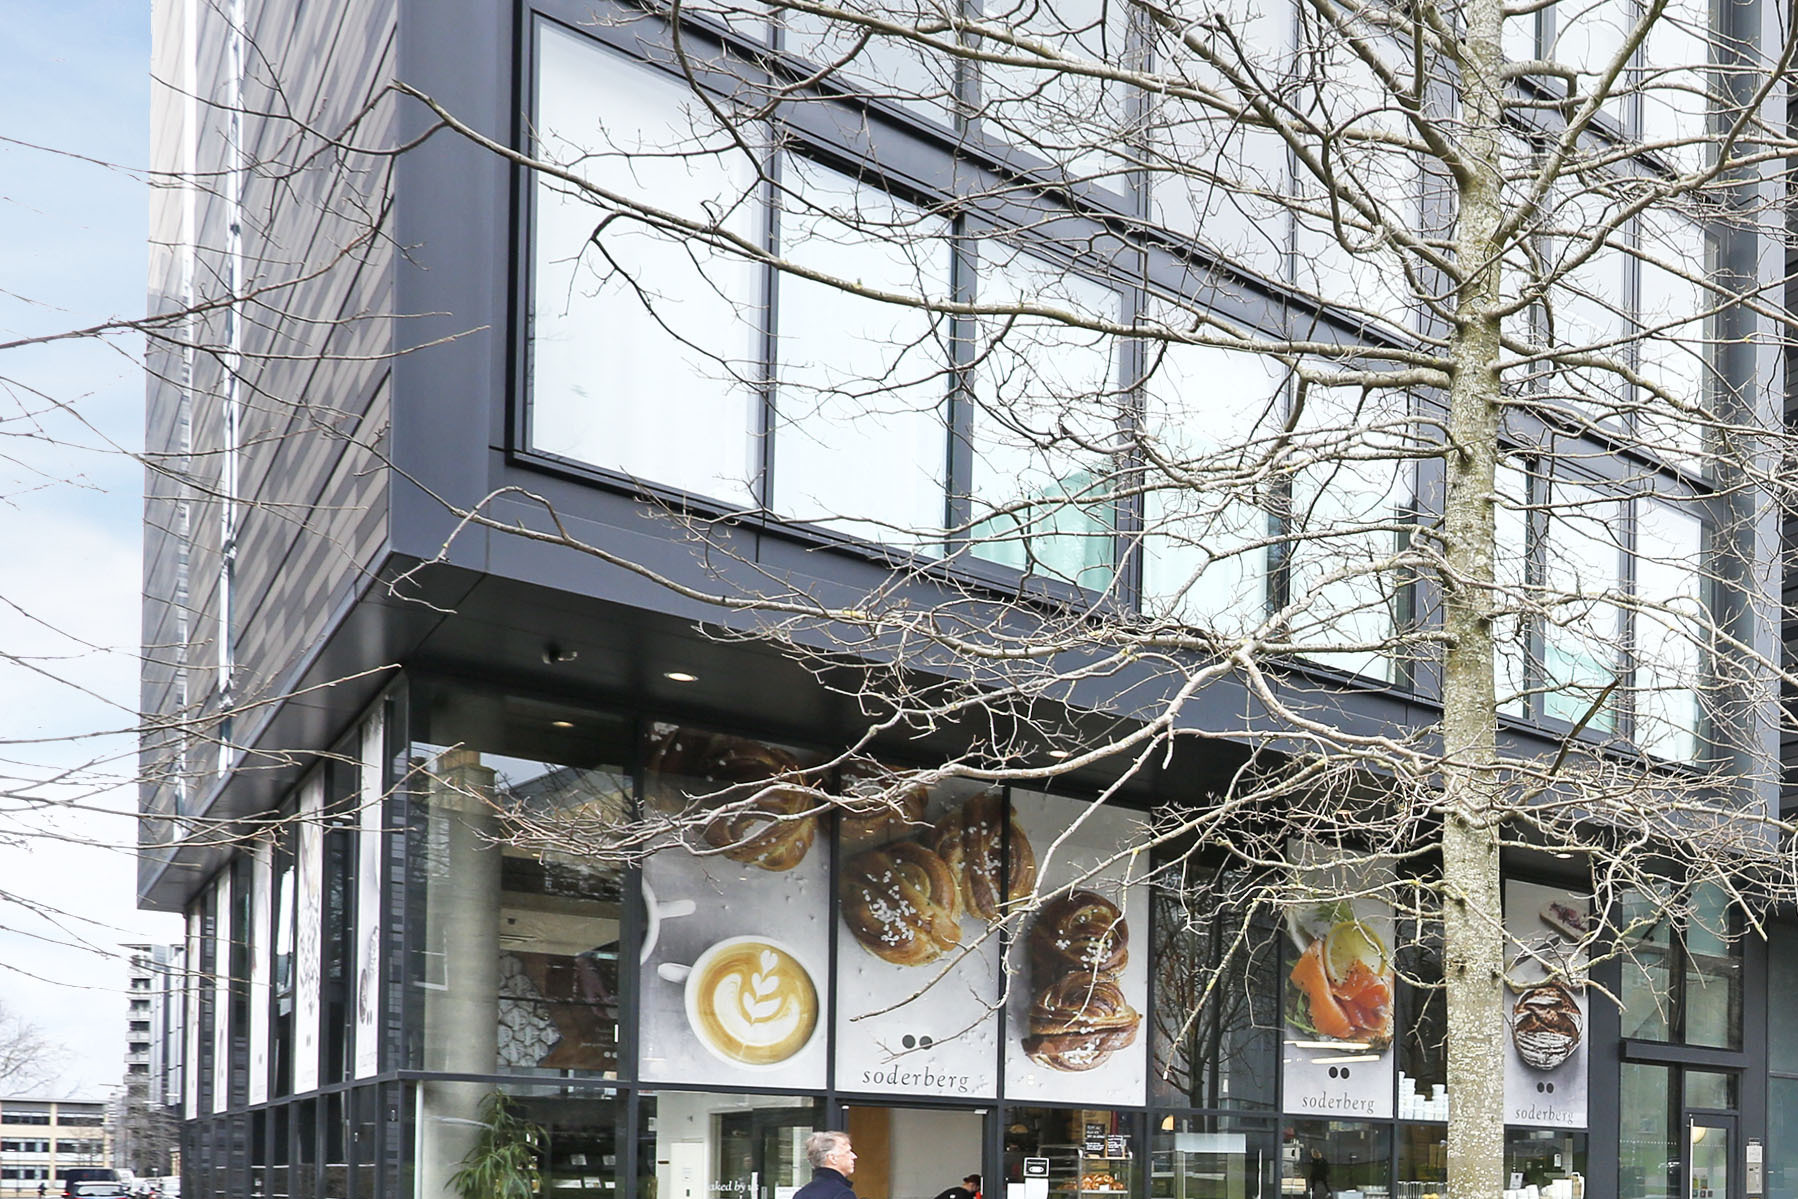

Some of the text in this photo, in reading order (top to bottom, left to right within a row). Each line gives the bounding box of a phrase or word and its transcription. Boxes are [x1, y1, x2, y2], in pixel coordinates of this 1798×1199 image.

[862, 1064, 969, 1093] soderberg
[1302, 1091, 1375, 1114] soderberg
[1515, 1104, 1574, 1125] soderberg
[708, 1180, 732, 1191] aked
